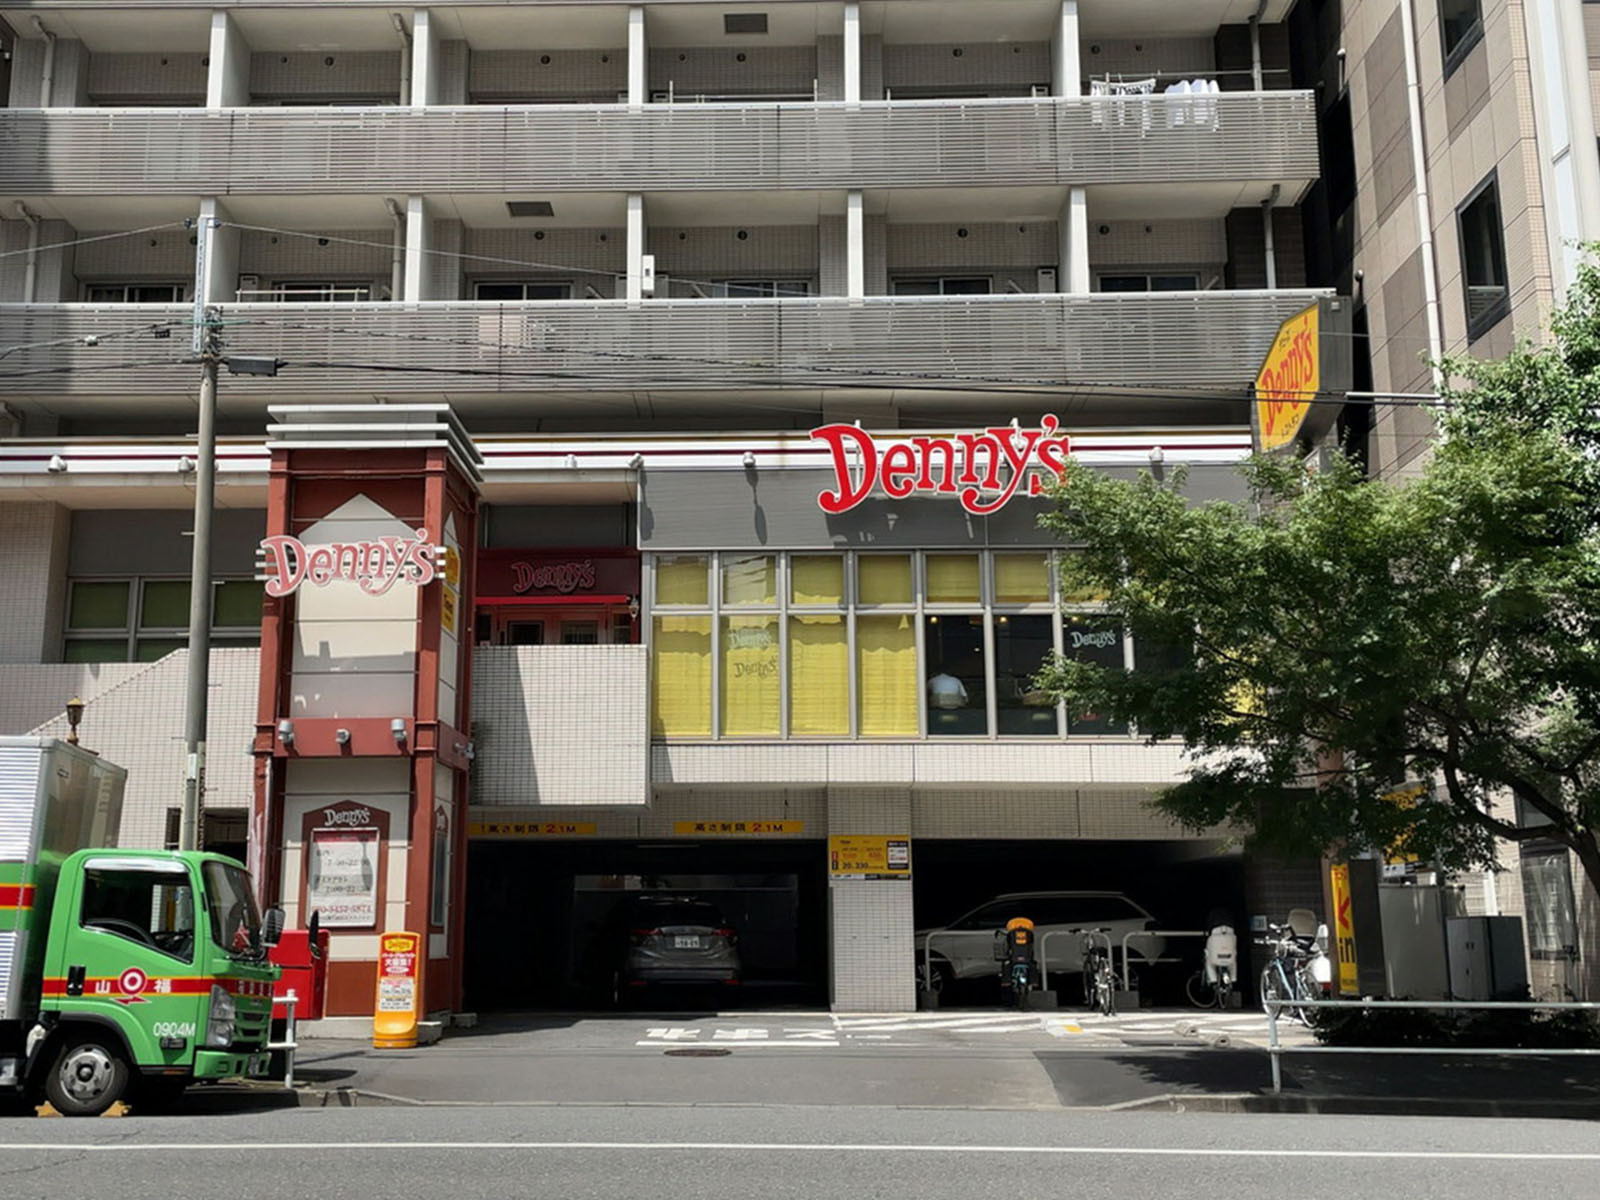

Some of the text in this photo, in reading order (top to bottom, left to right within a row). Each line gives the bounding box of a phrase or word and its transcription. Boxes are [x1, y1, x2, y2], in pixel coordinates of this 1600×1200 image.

[1261, 315, 1314, 437] Denny's
[809, 413, 1071, 516] Denny's
[260, 528, 436, 597] Denny's
[511, 559, 597, 594] Denny's
[1069, 630, 1117, 649] Denny's
[323, 807, 371, 827] Denny's
[95, 979, 172, 994] 山 福
